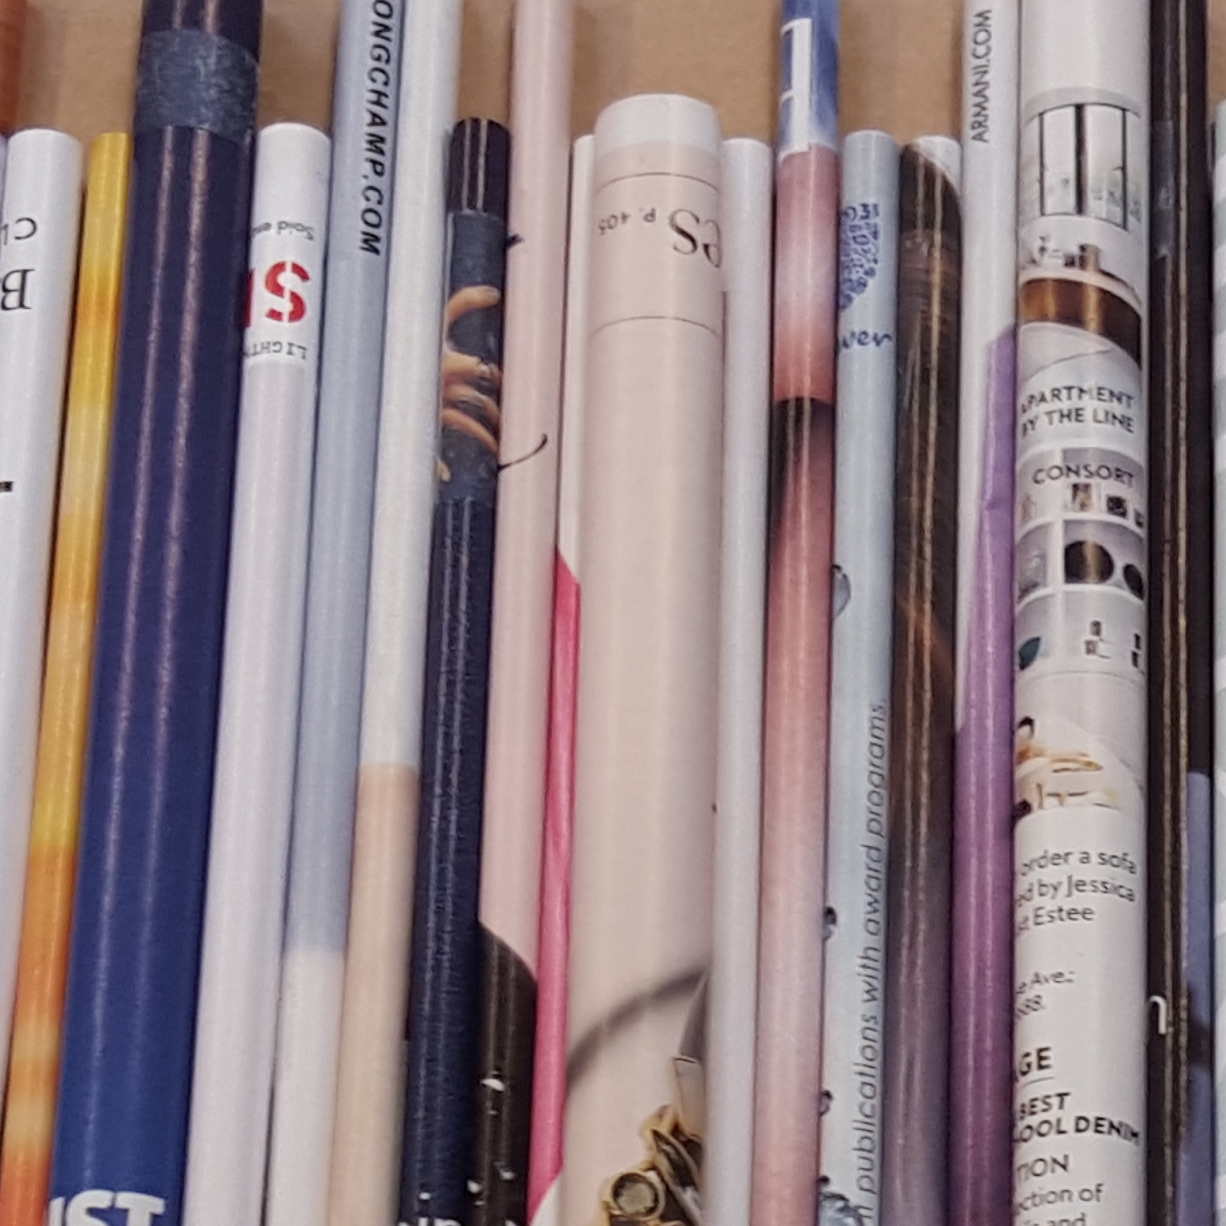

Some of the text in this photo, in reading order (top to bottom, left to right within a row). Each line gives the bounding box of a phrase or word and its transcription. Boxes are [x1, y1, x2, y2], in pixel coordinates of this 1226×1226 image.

[970, 10, 993, 143] ARMANI.COM
[358, 0, 393, 256] ONGCHAMP.COM
[244, 260, 311, 328] S
[1047, 408, 1085, 424] THE
[1093, 409, 1135, 434] LINE
[860, 845, 884, 937] award
[1038, 874, 1136, 902] by Jessica
[1080, 852, 1138, 875] a sofa
[1034, 906, 1095, 926] Estee
[857, 945, 882, 1004] with
[852, 1013, 880, 1195] publications
[1079, 1183, 1104, 1202] of
